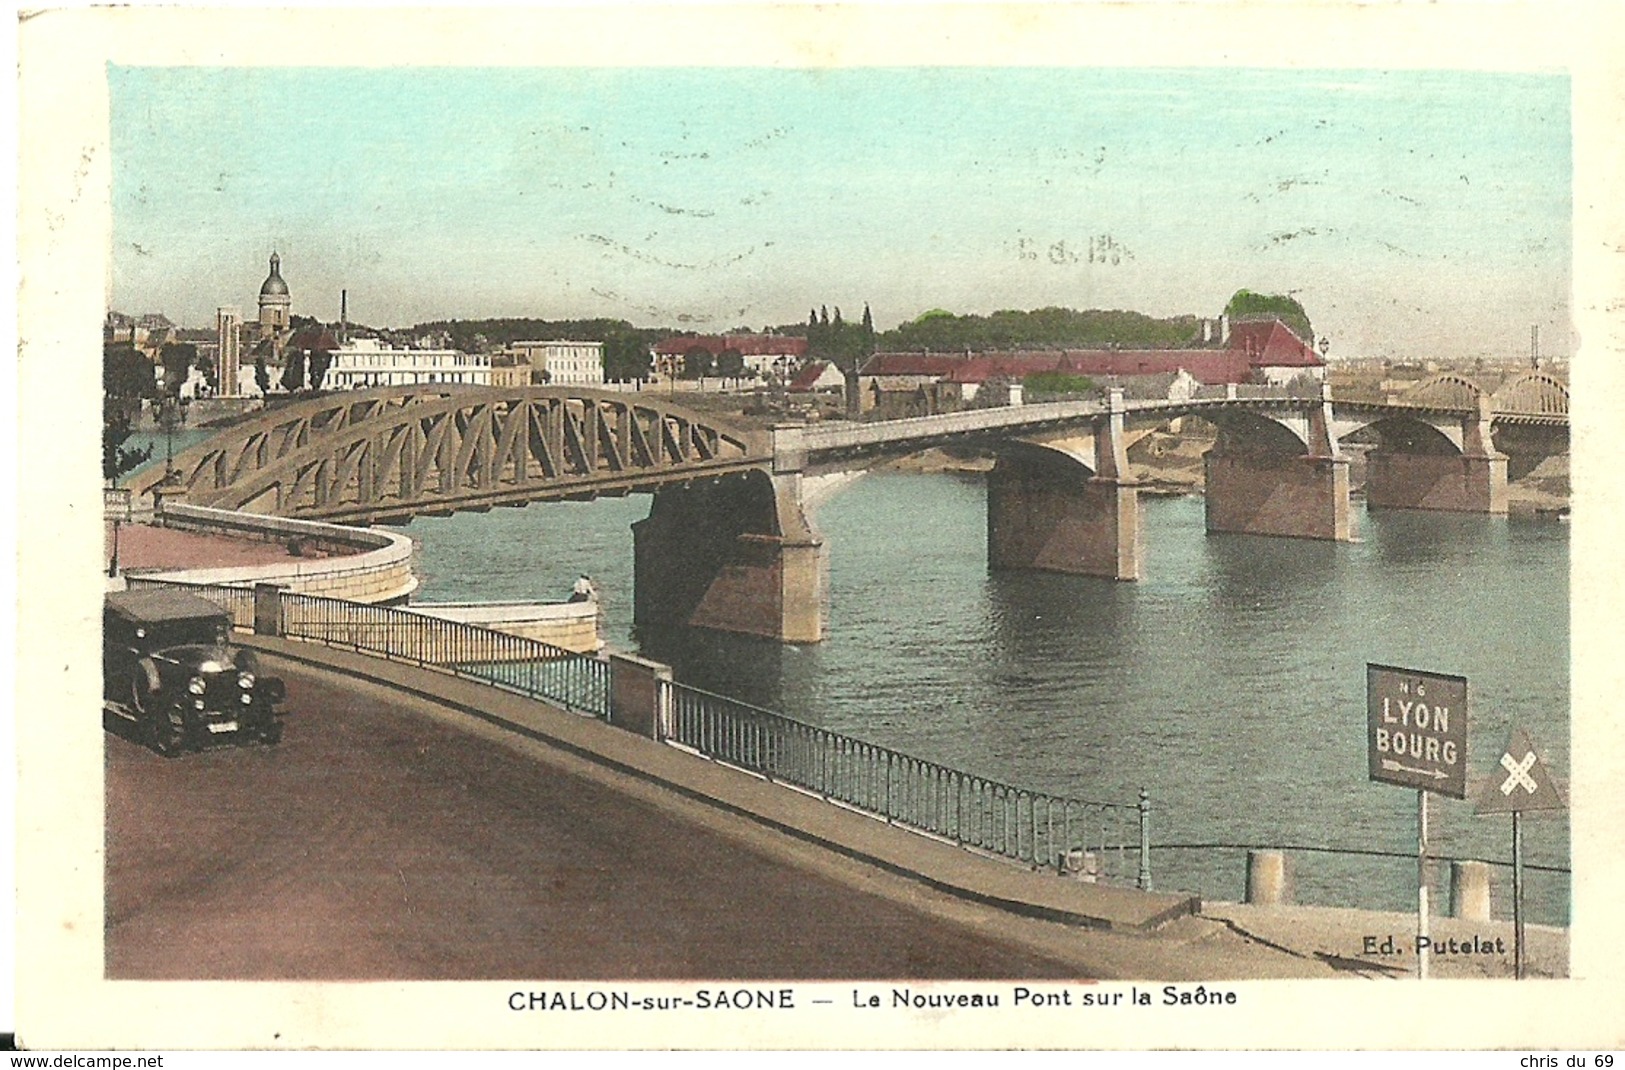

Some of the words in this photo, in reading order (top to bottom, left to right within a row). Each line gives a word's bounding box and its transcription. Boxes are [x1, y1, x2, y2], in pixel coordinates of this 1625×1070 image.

[1399, 682, 1409, 694] N
[1417, 684, 1426, 697] 6
[1383, 697, 1449, 733] LYON
[1376, 726, 1458, 765] BOURG
